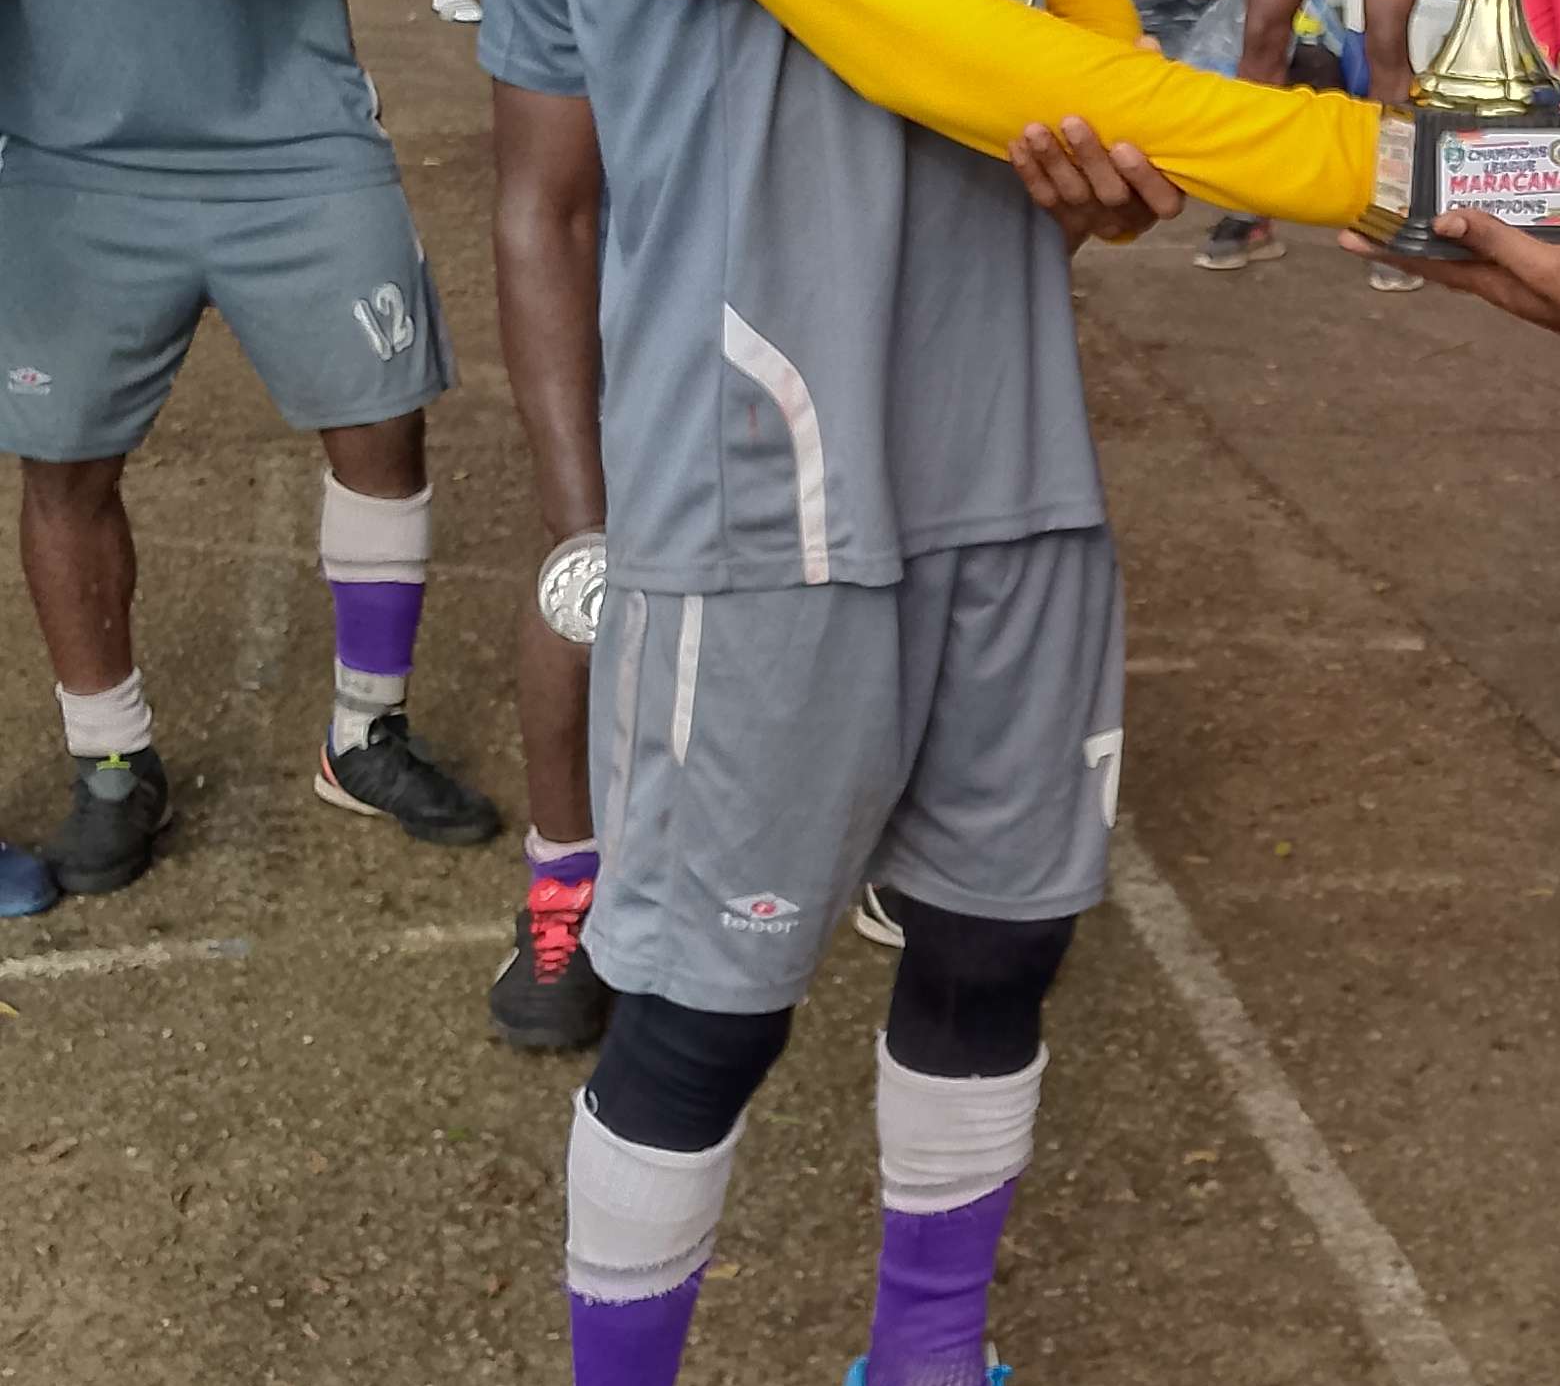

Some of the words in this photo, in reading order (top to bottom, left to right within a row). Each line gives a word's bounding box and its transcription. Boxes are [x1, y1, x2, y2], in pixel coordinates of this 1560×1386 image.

[1467, 145, 1548, 162] CHAMPIONS
[1484, 160, 1537, 174] LEAGUE
[353, 282, 416, 362] 12
